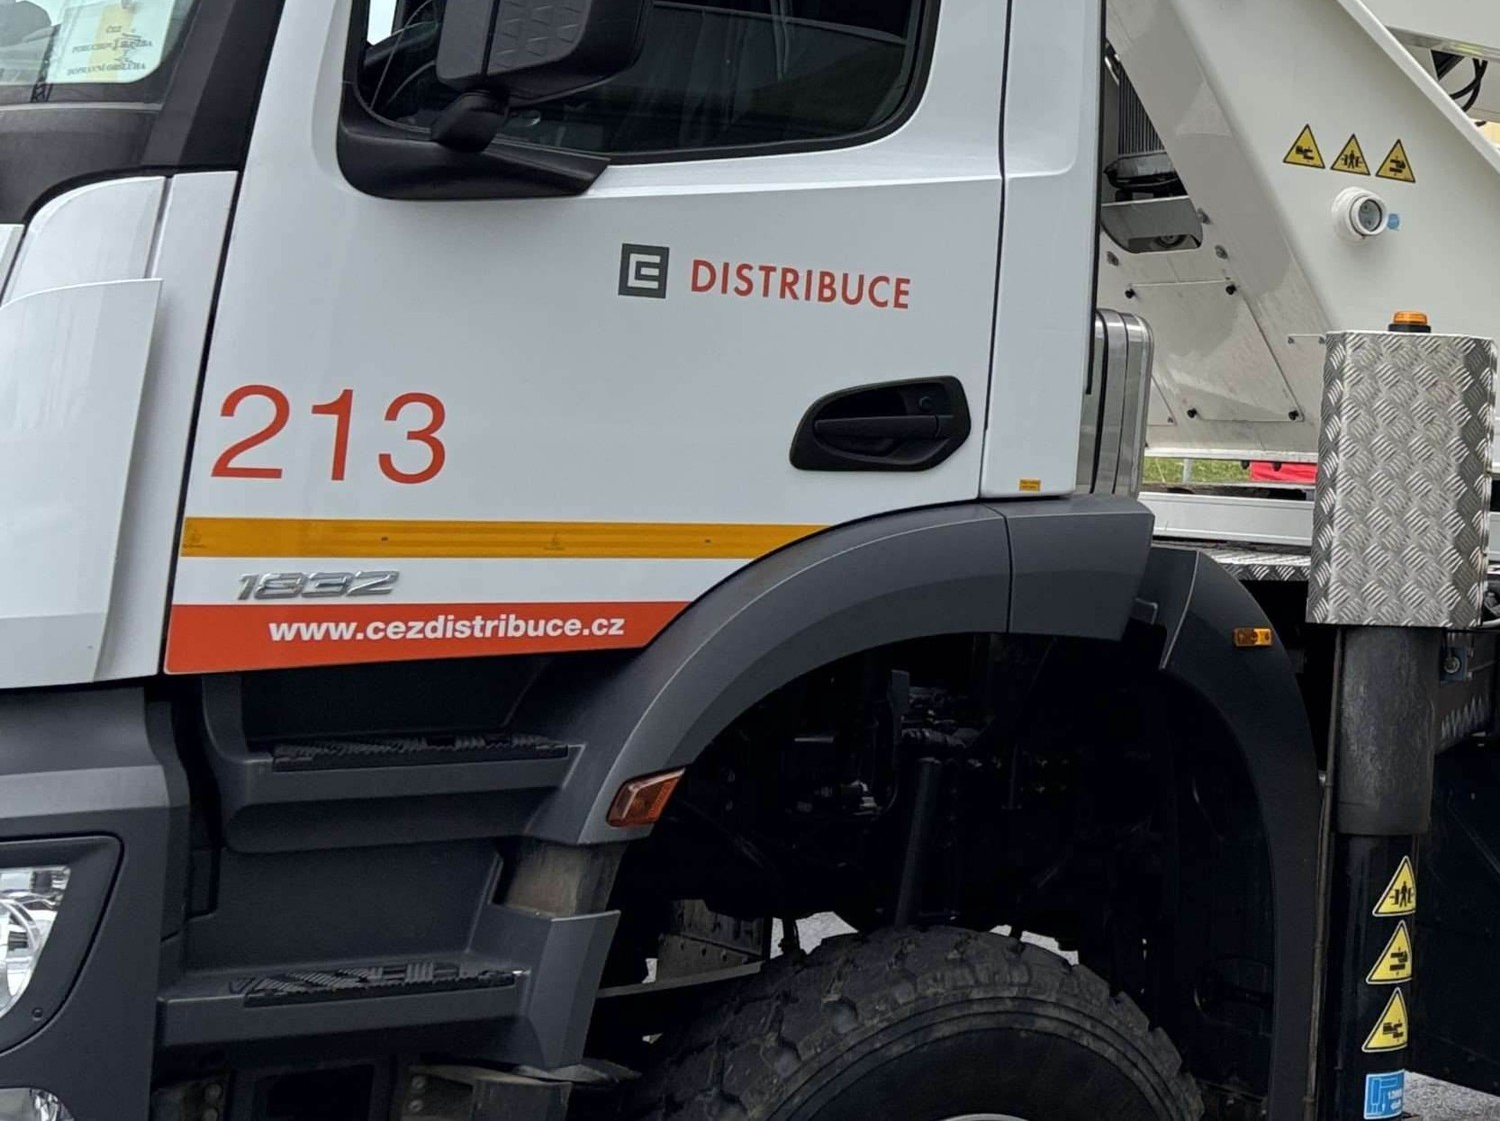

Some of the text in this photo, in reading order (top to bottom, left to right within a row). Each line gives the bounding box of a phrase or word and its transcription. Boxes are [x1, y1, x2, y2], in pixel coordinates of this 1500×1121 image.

[691, 259, 911, 309] DISTRIBUCE
[211, 384, 447, 484] 213
[237, 570, 400, 601] 1832
[268, 613, 625, 642] www.cezdistribuce.cz
